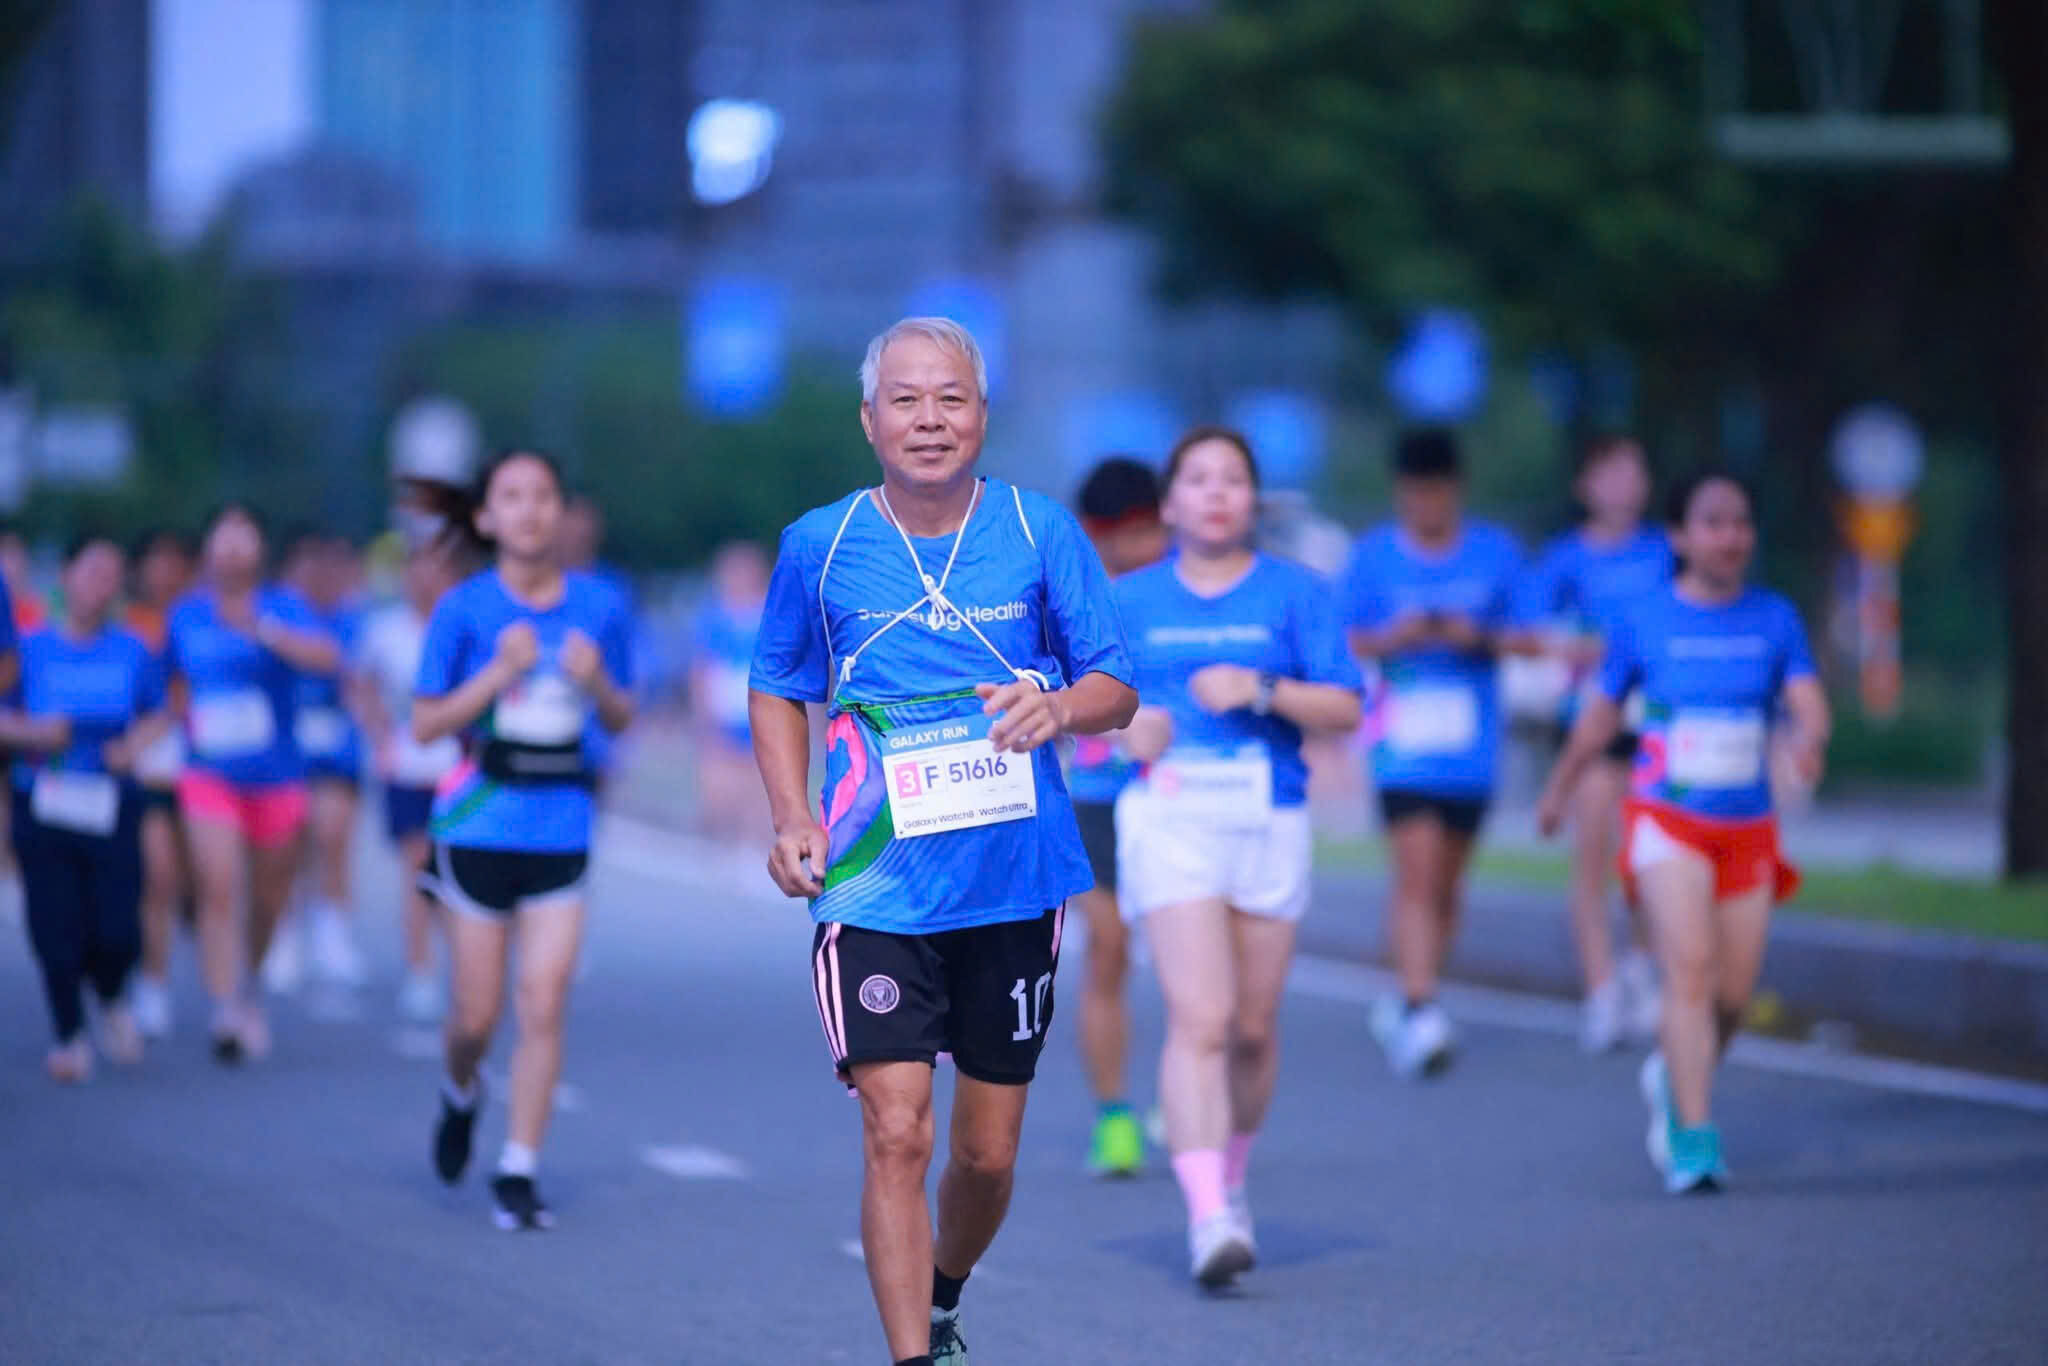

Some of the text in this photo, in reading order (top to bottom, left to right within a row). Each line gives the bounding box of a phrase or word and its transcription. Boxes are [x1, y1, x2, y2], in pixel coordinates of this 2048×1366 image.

[965, 600, 1028, 623] Health
[891, 725, 968, 748] GALAXY RUN
[900, 769, 917, 793] 3
[925, 766, 939, 788] F
[949, 756, 1008, 783] 51616
[904, 816, 938, 829] Galaxy
